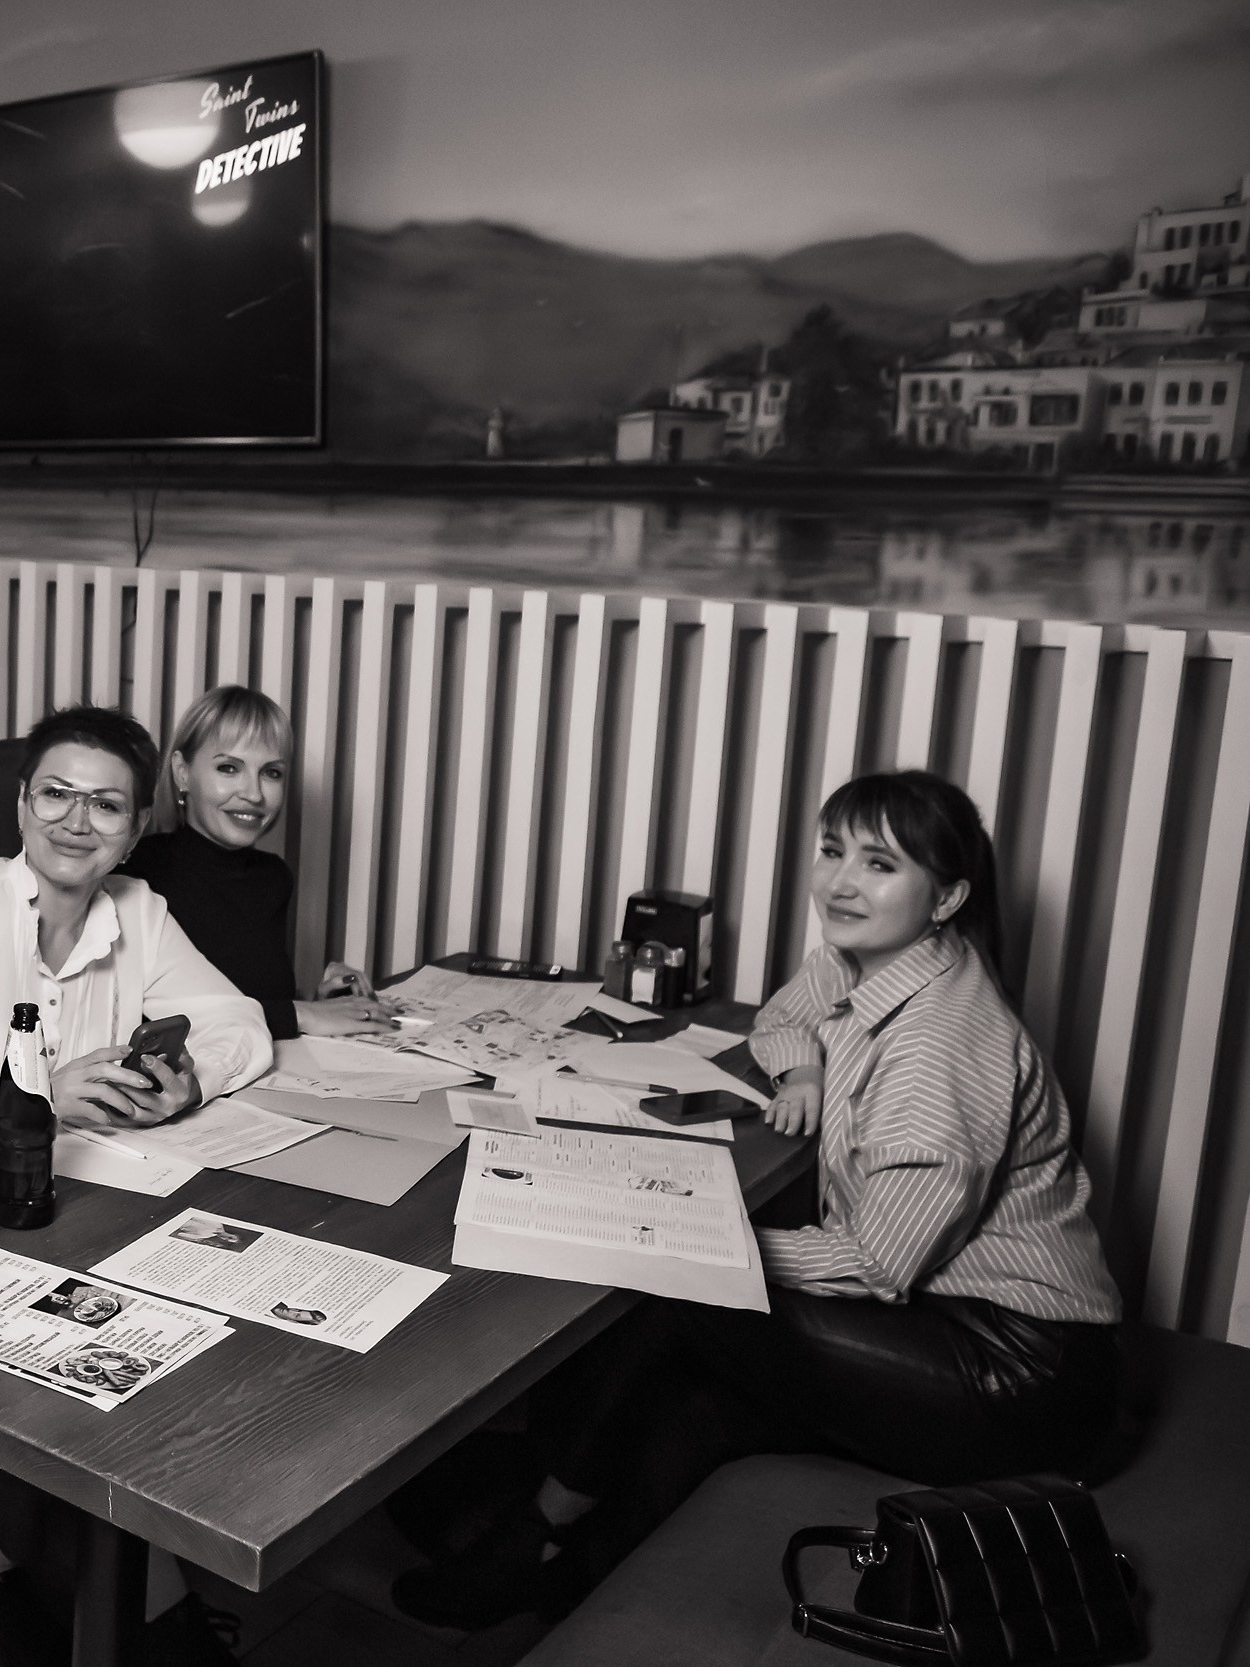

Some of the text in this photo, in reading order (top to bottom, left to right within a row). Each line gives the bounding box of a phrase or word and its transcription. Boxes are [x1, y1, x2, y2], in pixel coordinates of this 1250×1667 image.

[199, 75, 253, 119] Saint
[245, 98, 299, 133] Twins
[194, 123, 306, 194] DETECTIVE
